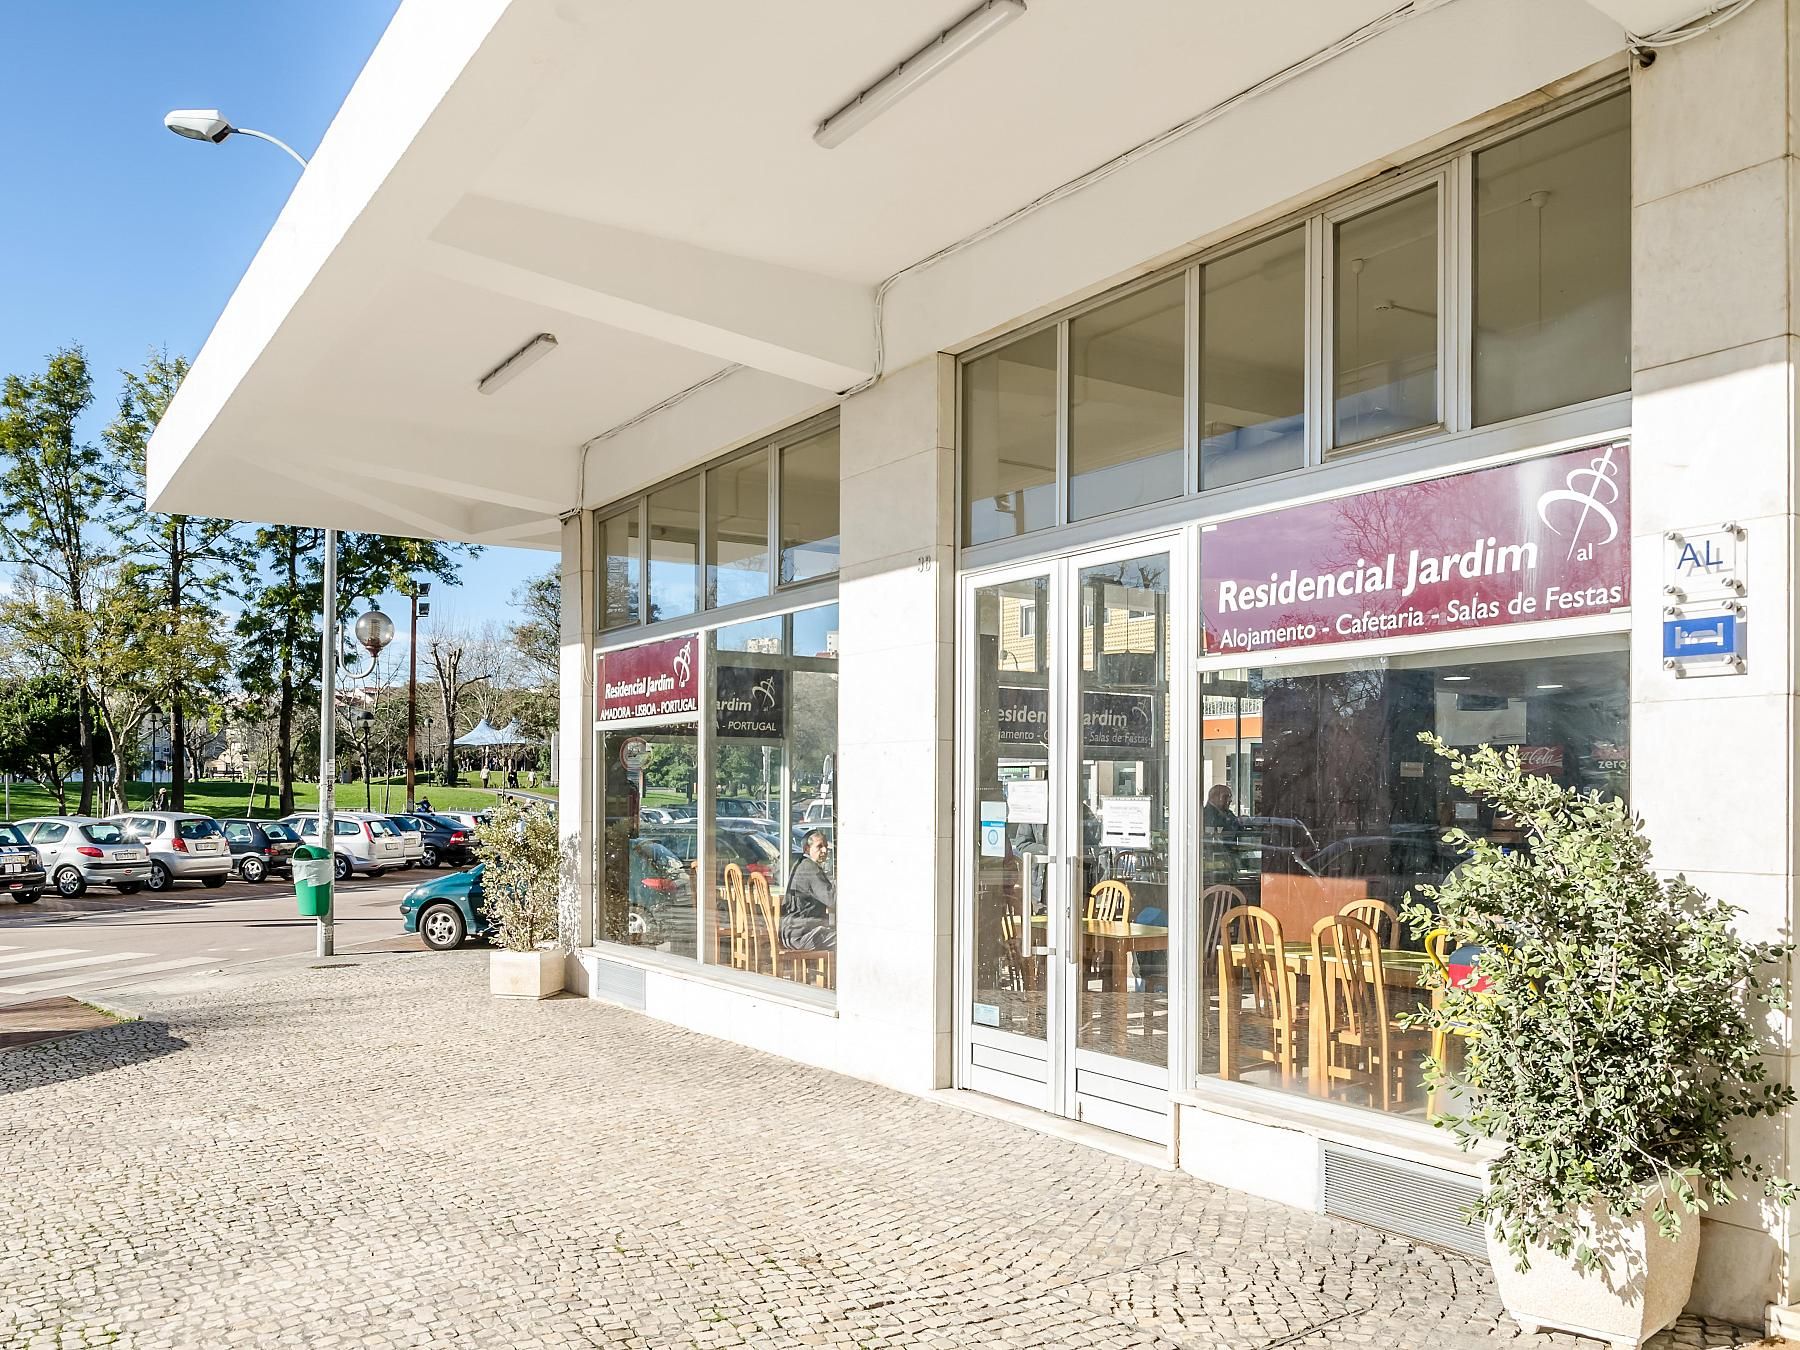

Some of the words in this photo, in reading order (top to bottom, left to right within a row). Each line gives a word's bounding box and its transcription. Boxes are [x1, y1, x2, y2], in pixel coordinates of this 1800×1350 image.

[1576, 543, 1593, 563] al
[1677, 540, 1723, 569] AL
[1218, 558, 1394, 614] Residencial
[1404, 539, 1538, 597] Jardim
[1220, 619, 1316, 650] Alojamento
[1336, 608, 1424, 635] Cafetaria
[1446, 598, 1500, 623] Salas
[1508, 592, 1536, 615] de
[1545, 585, 1622, 609] Festas
[605, 677, 646, 699] Residencial
[646, 674, 674, 697] Jardim
[600, 706, 631, 720] AMADORA
[635, 703, 656, 717] LISBOA
[661, 698, 697, 713] PORTUGAL
[716, 698, 751, 712] ardim
[728, 721, 777, 732] PORTUGAL
[1083, 709, 1128, 727] ardim
[1598, 759, 1628, 770] zero
